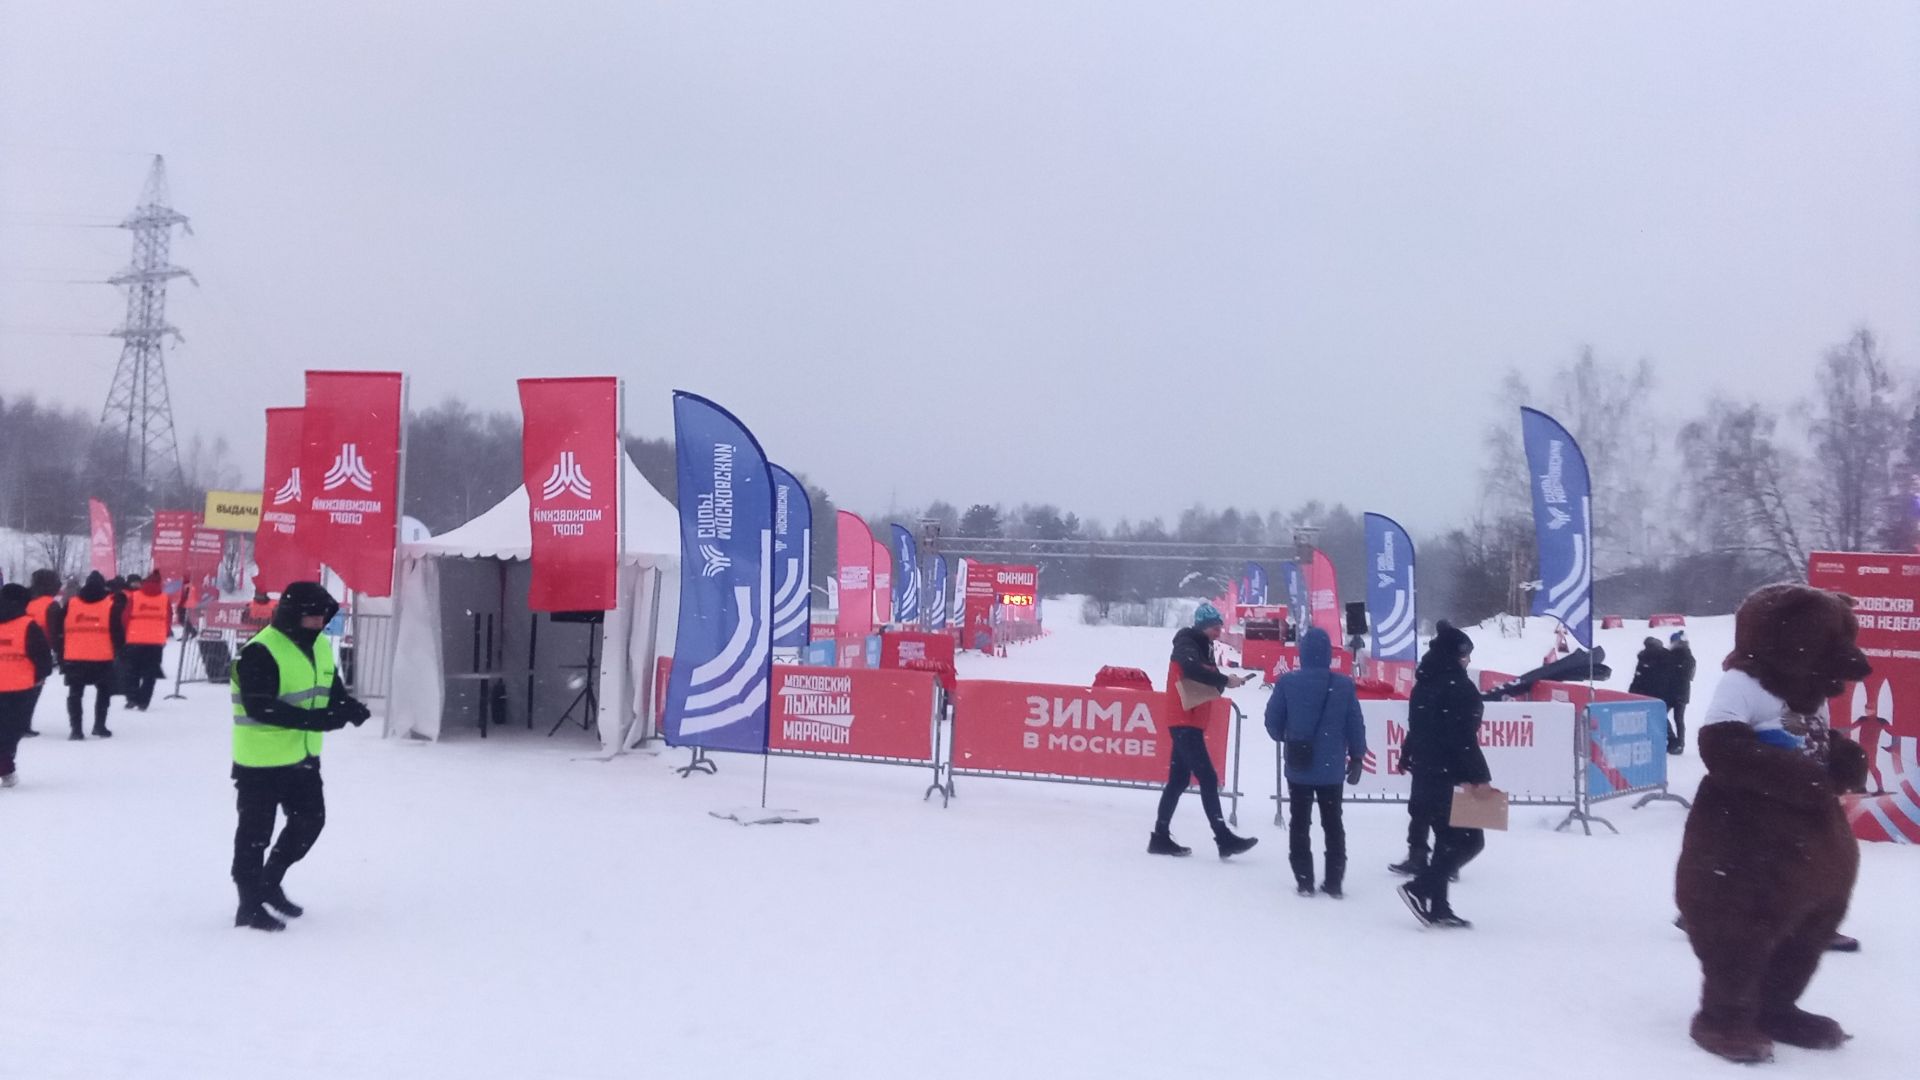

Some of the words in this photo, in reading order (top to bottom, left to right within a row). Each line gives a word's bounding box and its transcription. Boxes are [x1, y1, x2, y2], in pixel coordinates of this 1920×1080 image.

[216, 504, 259, 516] ВЫДАЧА
[997, 572, 1034, 585] ФИНИШ
[784, 675, 850, 692] МОСКОВСКИЙ
[784, 694, 850, 714] ЛЫЖНЫЙ
[1024, 696, 1157, 734] ЗИМА
[783, 720, 850, 744] МАРАФОН
[1387, 715, 1534, 747] МСКИЙ
[1023, 732, 1039, 749] В
[1048, 734, 1157, 757] МОСКВЕ
